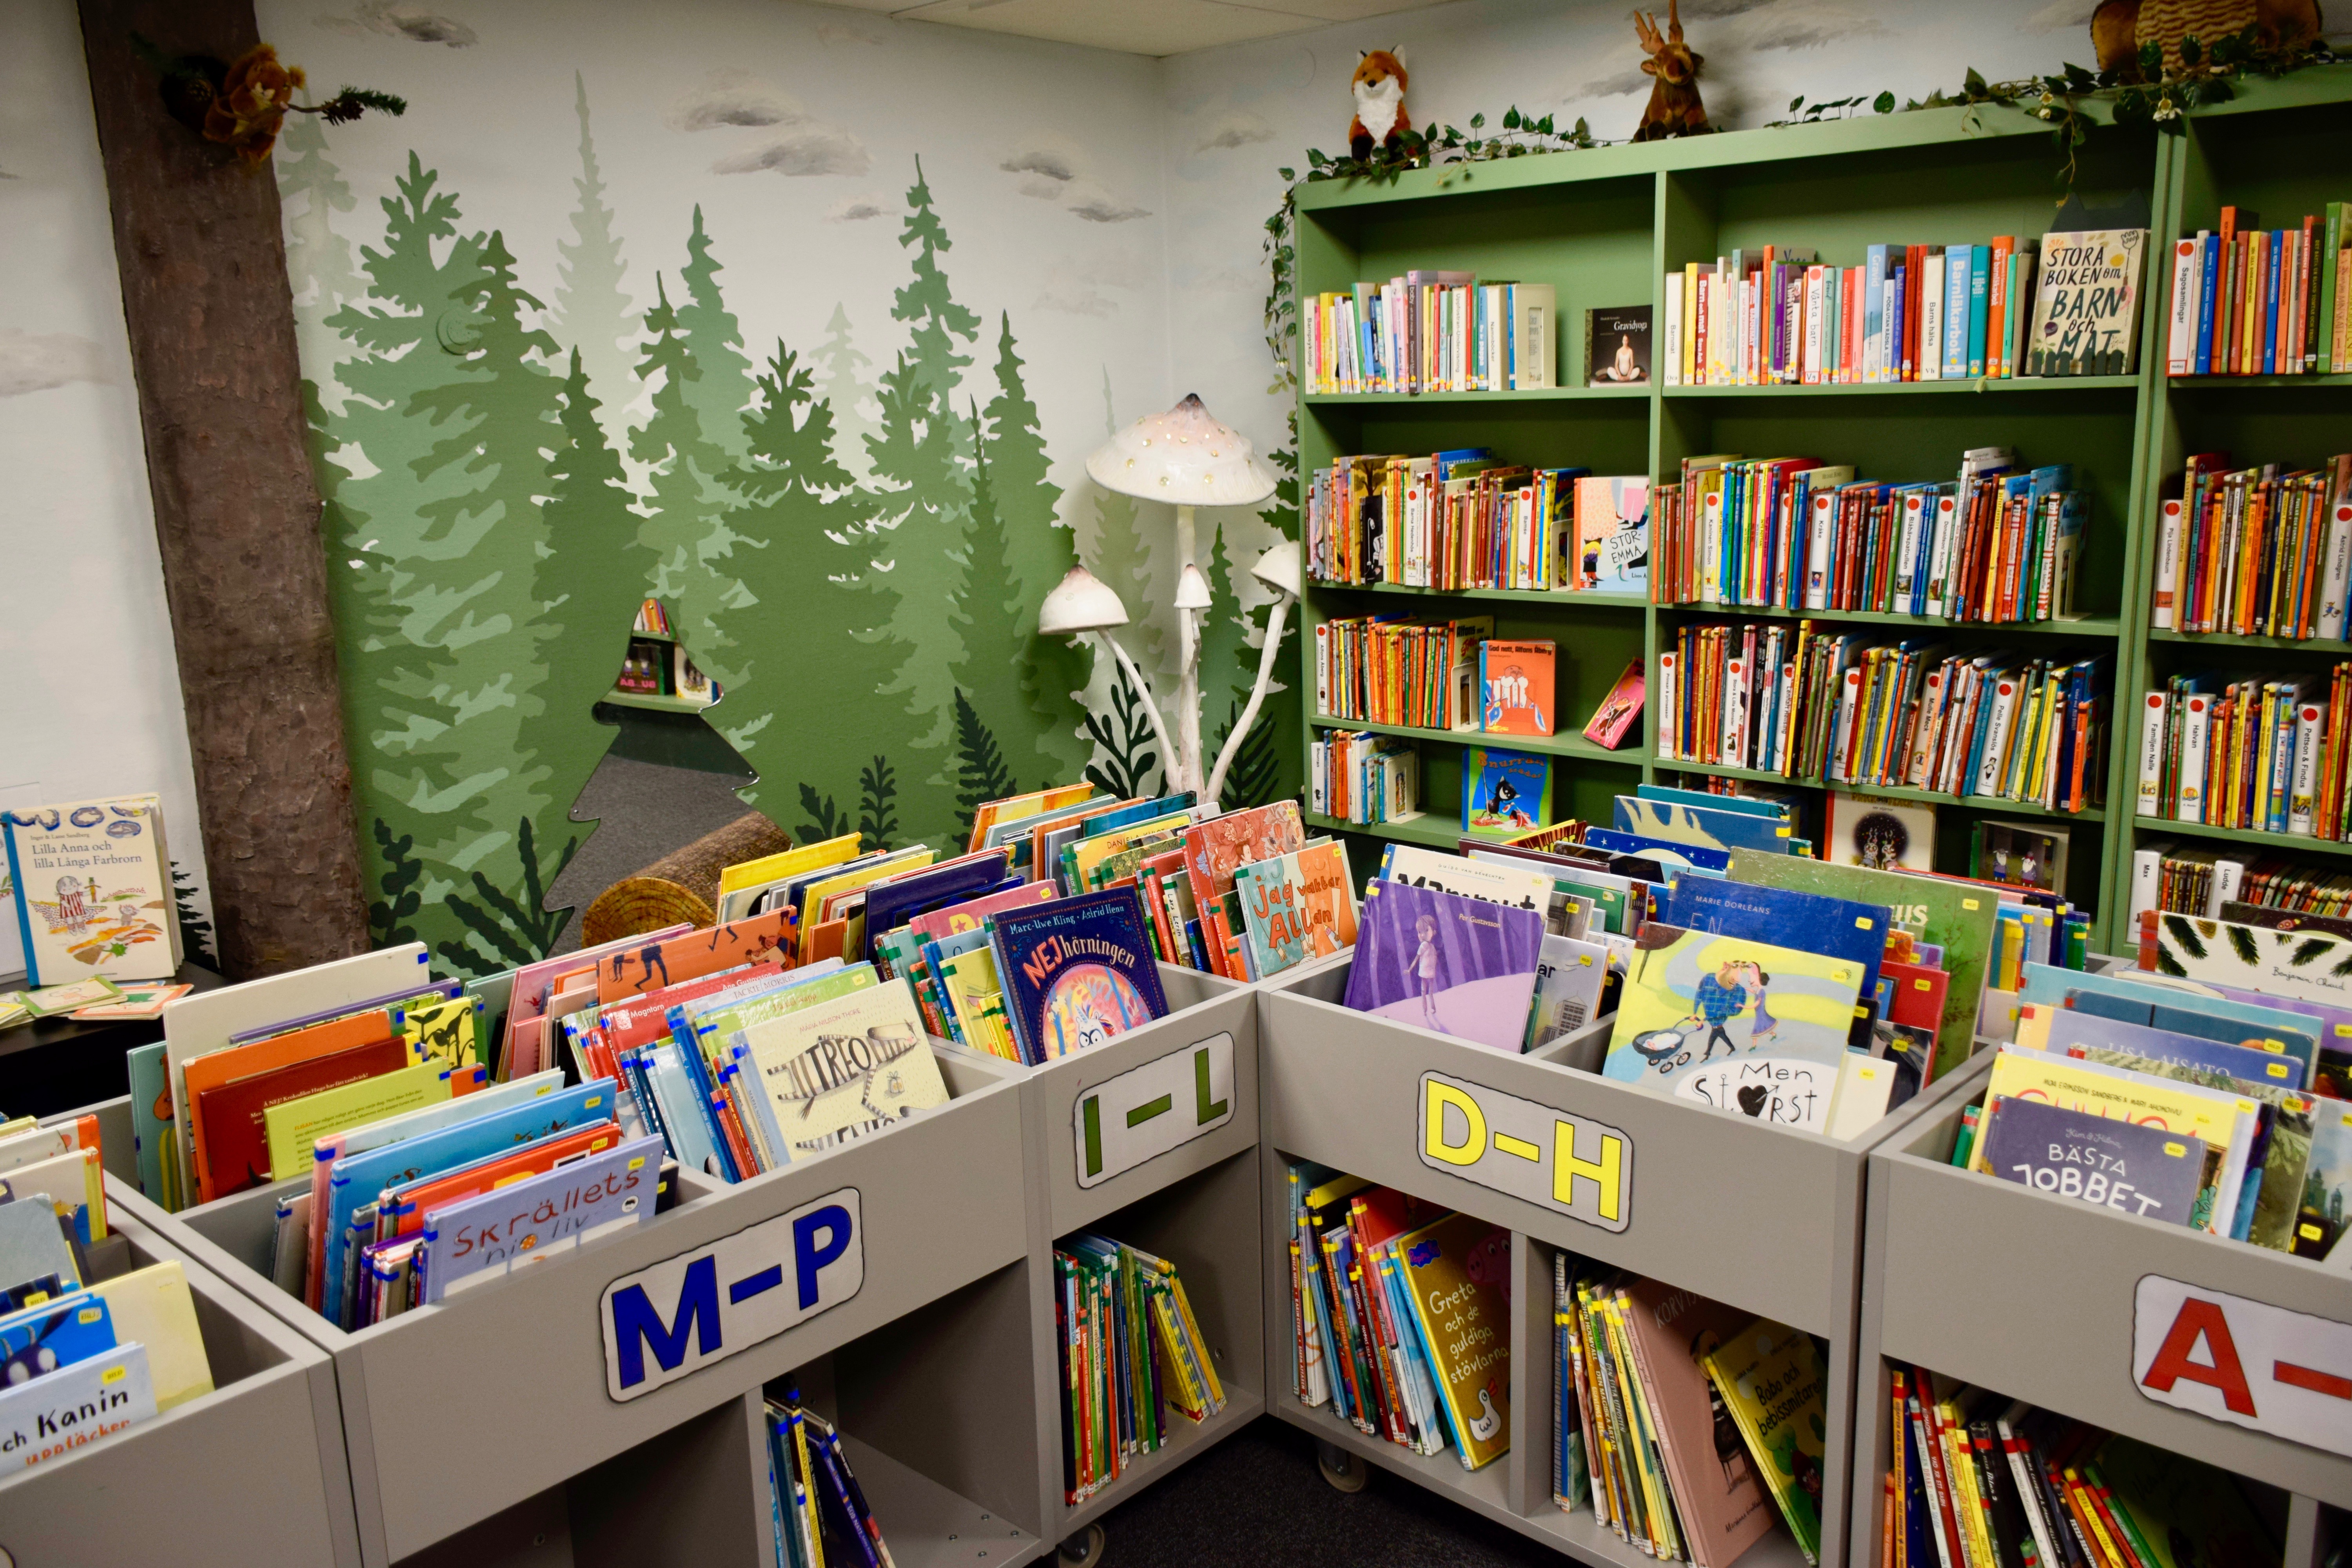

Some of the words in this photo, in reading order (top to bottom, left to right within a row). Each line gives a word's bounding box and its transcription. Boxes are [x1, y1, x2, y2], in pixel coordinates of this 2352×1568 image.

[2046, 247, 2103, 267] STORA
[1871, 255, 1880, 287] Gravid
[2045, 268, 2102, 286] BOKEN
[2103, 268, 2121, 278] om
[2049, 286, 2125, 320] BARN
[2175, 267, 2189, 323] Sagosamlingar
[1949, 261, 1965, 356] Barnläkarbok
[1614, 320, 1647, 332] Gravidyoga
[1811, 324, 1819, 347] barn
[2068, 315, 2095, 333] och
[2055, 330, 2121, 361] MAT
[1610, 531, 1641, 549] STOR-
[1902, 516, 1914, 569] Blåbärspatrullen
[2337, 535, 2347, 553] Astrid
[1611, 544, 1642, 563] EMMA
[2162, 539, 2172, 573] Lindenbaum
[2334, 554, 2345, 581] Lindgren
[1926, 697, 1935, 714] Mulle
[1995, 705, 2005, 721] Pelle
[1922, 715, 1931, 732] Meck
[2190, 724, 2199, 748] Halvan
[1989, 722, 2001, 751] Svanslös
[2147, 723, 2158, 752] Familjen
[2302, 728, 2312, 755] Pettson
[2145, 753, 2155, 771] Nalle
[2298, 764, 2308, 788] Findus
[32, 844, 56, 854] Lilla
[60, 843, 89, 853] Anna
[92, 841, 112, 850] och
[1182, 850, 1191, 867] William
[34, 858, 54, 868] lilla
[58, 857, 90, 869] Långa
[93, 854, 142, 864] Farbrorn
[2221, 869, 2230, 890] Ludde
[1254, 875, 1294, 919] jag
[1298, 875, 1340, 897] vaktar
[1695, 895, 1721, 906] MARIE
[1725, 900, 1770, 915] DORLÉANS
[1010, 919, 1052, 934] Marc-Uwe
[1053, 915, 1074, 927] Kling
[1082, 907, 1104, 920] Astrid
[1105, 904, 1124, 915] Henn
[1167, 893, 1177, 910] Lars
[1172, 915, 1182, 936] Lerin
[1470, 916, 1500, 928] Gustavsson
[1212, 915, 1221, 933] Barbro
[1217, 933, 1227, 956] Lindgren
[722, 983, 735, 991] Ane
[737, 973, 773, 987] Gustavsson
[734, 984, 760, 999] JACKIE
[764, 974, 795, 990] MORRIS
[2272, 967, 2313, 984] Benjamin
[631, 1003, 665, 1018] Magntorn
[800, 1022, 818, 1033] MARIA
[818, 1015, 840, 1027] NILSSON
[842, 1007, 861, 1020] THORE
[928, 1005, 937, 1018] John
[931, 1018, 942, 1035] Kilaka
[610, 1049, 621, 1071] Magntorn
[2109, 1042, 2145, 1058] LISA
[2160, 1055, 2231, 1077] AISATO
[2269, 1066, 2285, 1075] BILD
[1740, 1062, 1813, 1083] Men
[283, 1090, 310, 1102] Krokodilen
[345, 1073, 368, 1083] tandvärk!
[2044, 1078, 2057, 1087] MOA
[2059, 1082, 2089, 1095] ERIKSSON
[2091, 1090, 2122, 1102] SANDBERG
[2131, 1098, 2146, 1107] MARI
[697, 1100, 705, 1111] OM
[2285, 1099, 2301, 1108] BILD
[295, 1122, 313, 1131] FLISAN
[2049, 1144, 2126, 1177] BÄSTA
[2013, 1164, 2161, 1216] JOBBET
[454, 1169, 640, 1258] Skrällets
[552, 1214, 589, 1239] liv
[1430, 1283, 1476, 1314] Greta
[1352, 1284, 1362, 1310] DAVIDSSON,
[1361, 1325, 1369, 1345] MAMMAS
[1445, 1312, 1465, 1332] och
[1468, 1306, 1479, 1320] de
[1450, 1327, 1493, 1359] guldiga
[1584, 1321, 1598, 1361] HOLMVALL
[1451, 1347, 1509, 1383] stövlarna
[1594, 1370, 1603, 1385] DEN
[1756, 1381, 1780, 1407] Bobo
[1782, 1361, 1801, 1386] och
[38, 1389, 128, 1439] Kanin
[1598, 1388, 1611, 1423] MAGISKA
[1608, 1378, 1618, 1397] SISTA
[1613, 1399, 1626, 1433] UTPOSTEN
[1756, 1377, 1824, 1437] bebissmitaren
[799, 1441, 811, 1486] NORDQVIST
